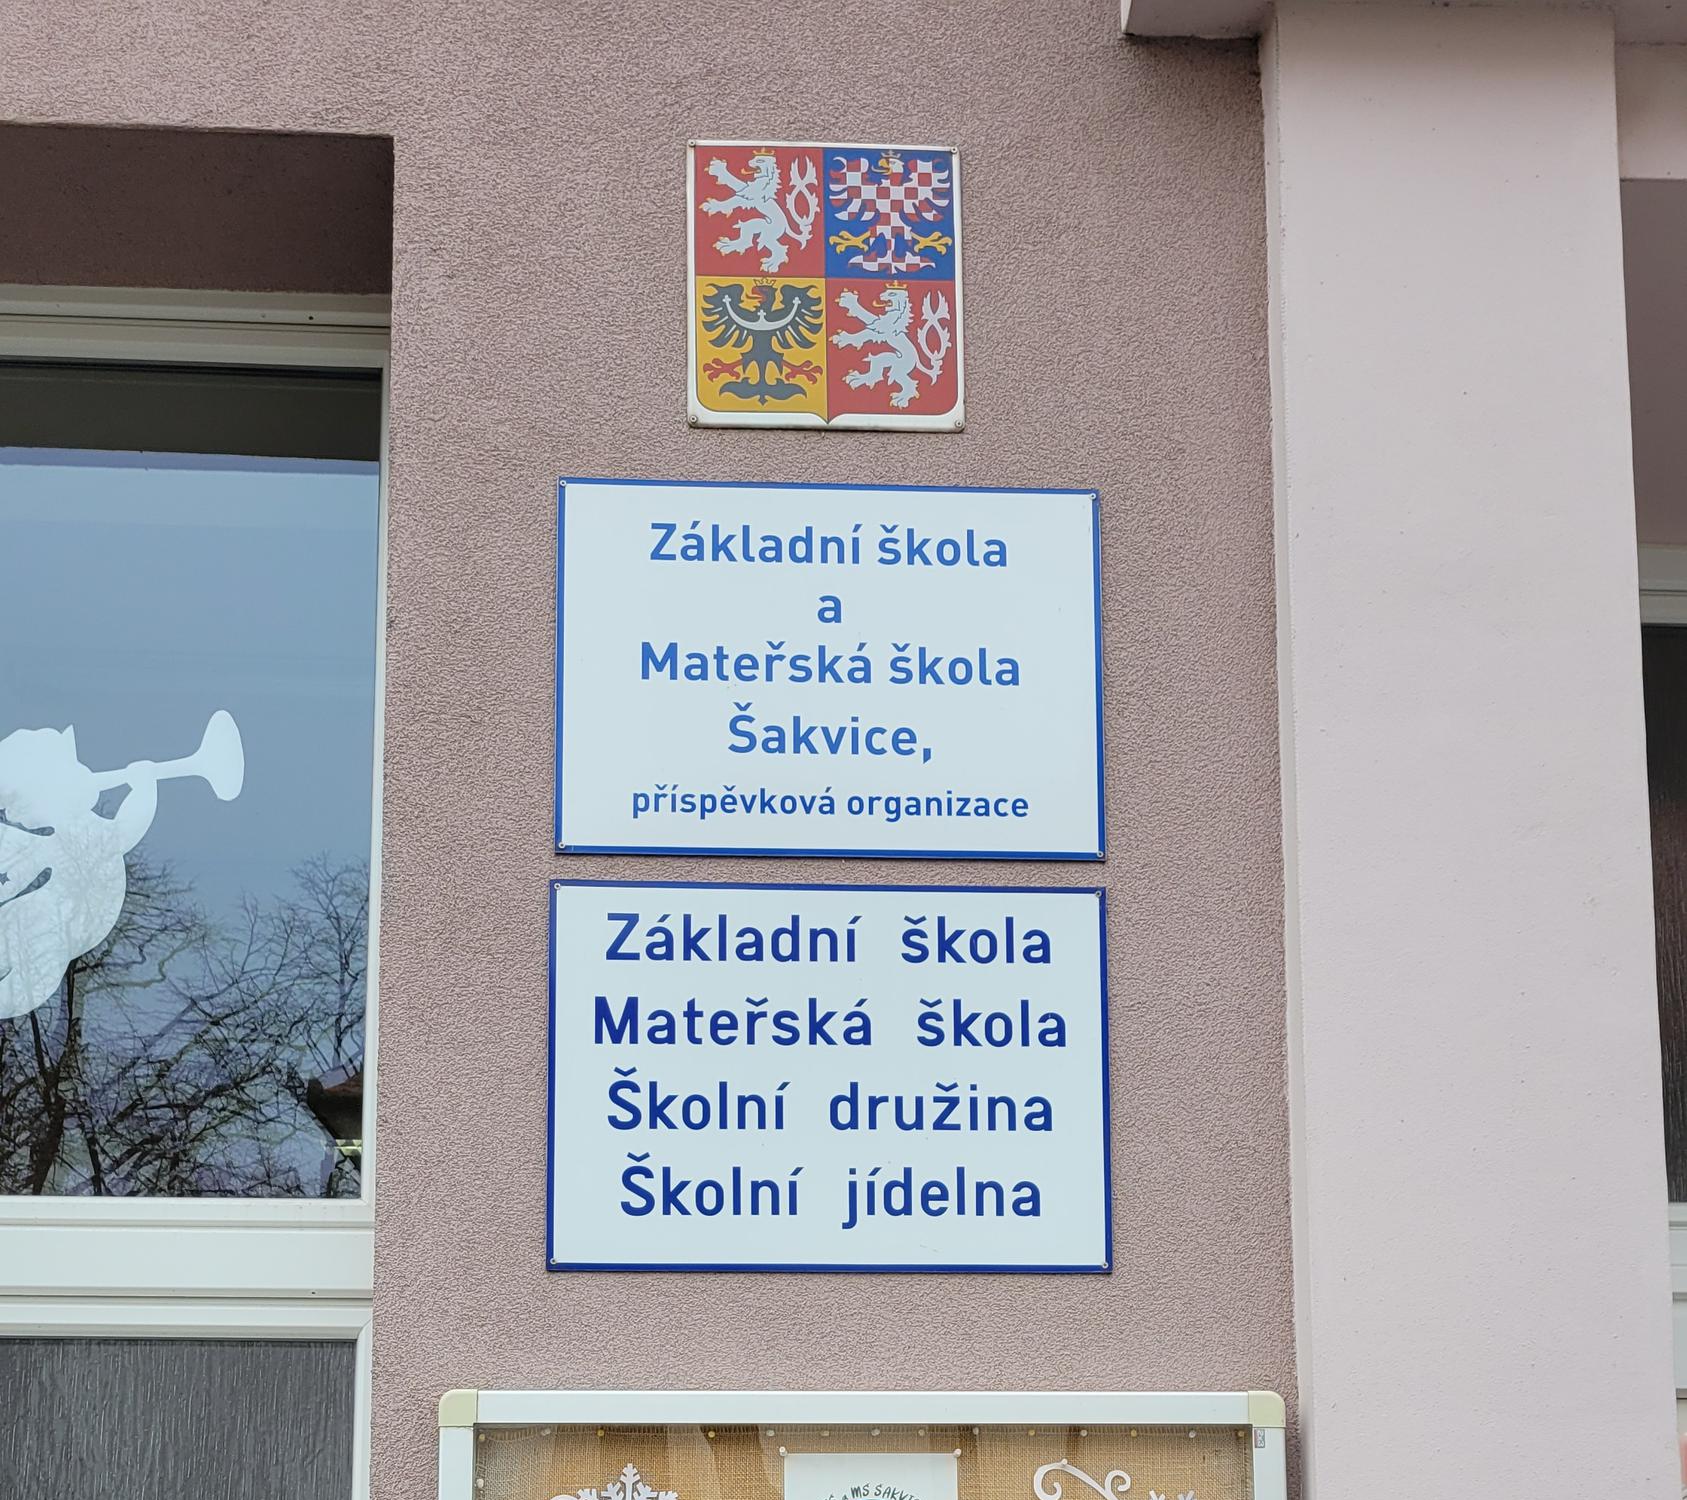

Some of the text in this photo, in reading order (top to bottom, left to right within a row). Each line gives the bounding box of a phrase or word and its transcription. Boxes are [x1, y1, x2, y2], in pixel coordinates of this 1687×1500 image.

[649, 521, 1009, 568] Základní škola
[816, 595, 843, 624] a
[640, 641, 1022, 687] Mateřská škola
[727, 701, 933, 765] Šakvice,
[631, 783, 1030, 823] příspěvková organizace
[605, 912, 1053, 965] Základní škola
[593, 995, 1068, 1048] Mateřská škola
[606, 1066, 1054, 1132] Školní družina
[620, 1151, 1042, 1230] Školní jídelna
